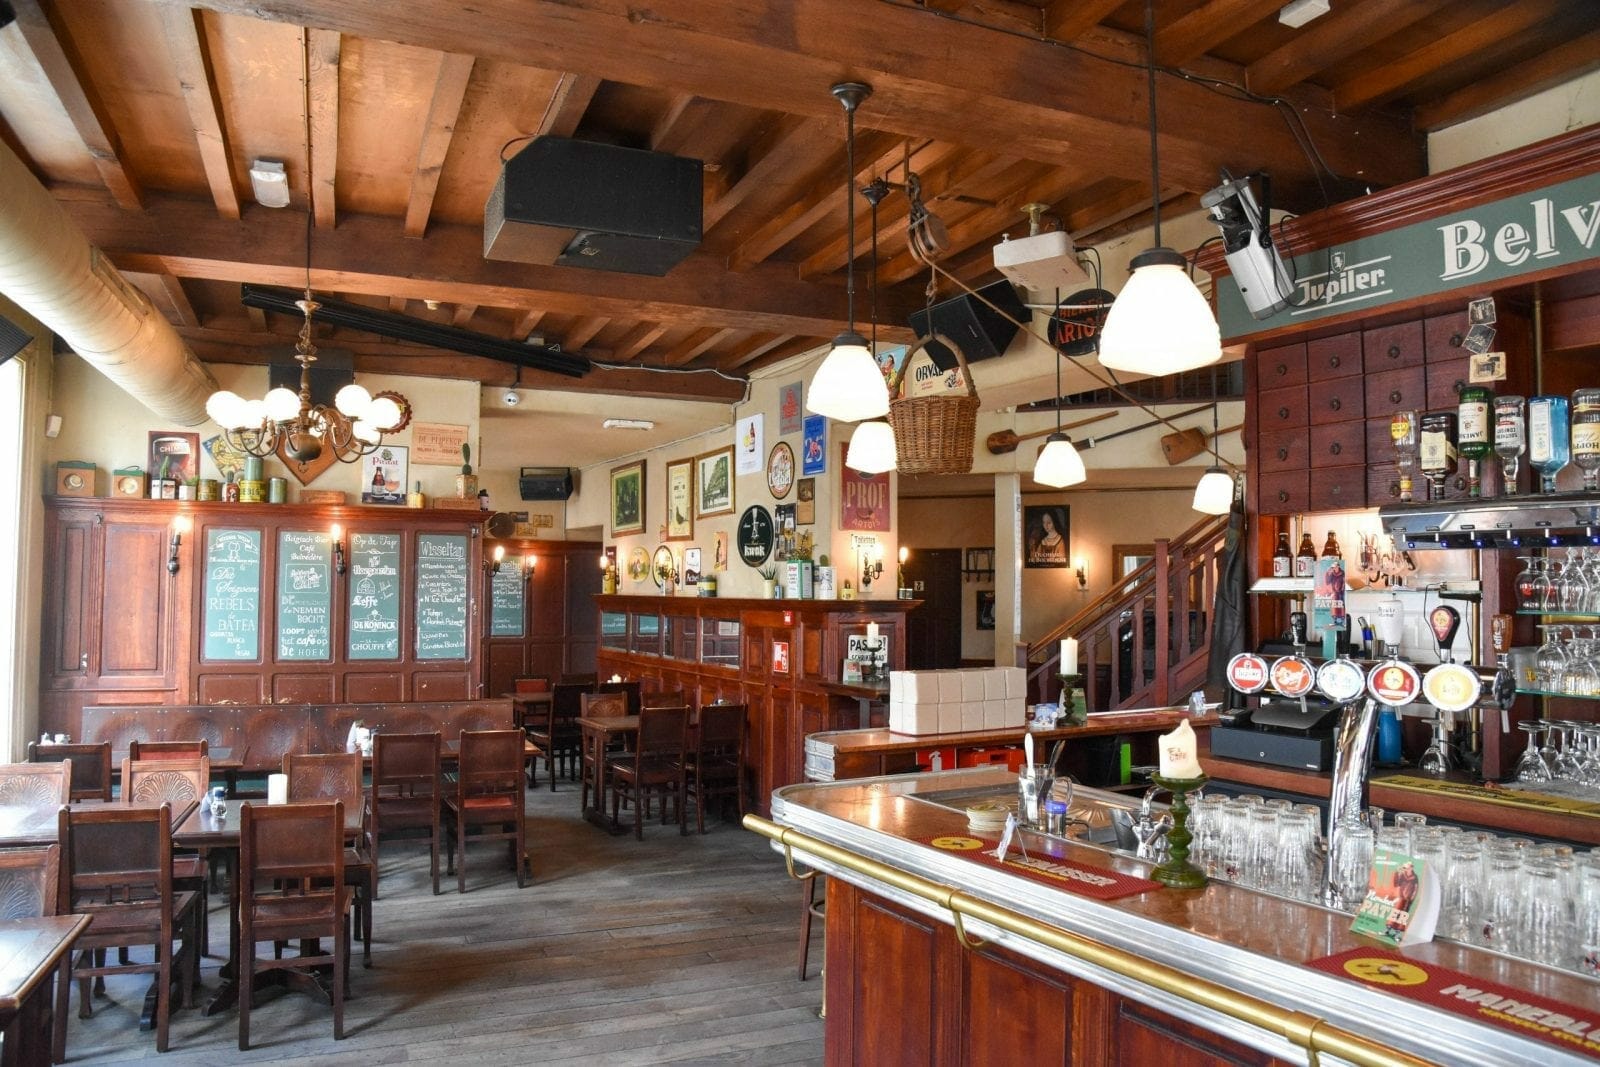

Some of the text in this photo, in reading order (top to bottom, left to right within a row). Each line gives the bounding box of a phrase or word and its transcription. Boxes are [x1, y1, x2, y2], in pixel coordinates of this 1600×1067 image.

[846, 481, 887, 509] PROF
[209, 597, 255, 611] REBELS
[292, 606, 326, 614] NEMEN
[1313, 599, 1345, 609] PATER
[298, 648, 325, 657] HOEK
[1360, 901, 1410, 925] PATER
